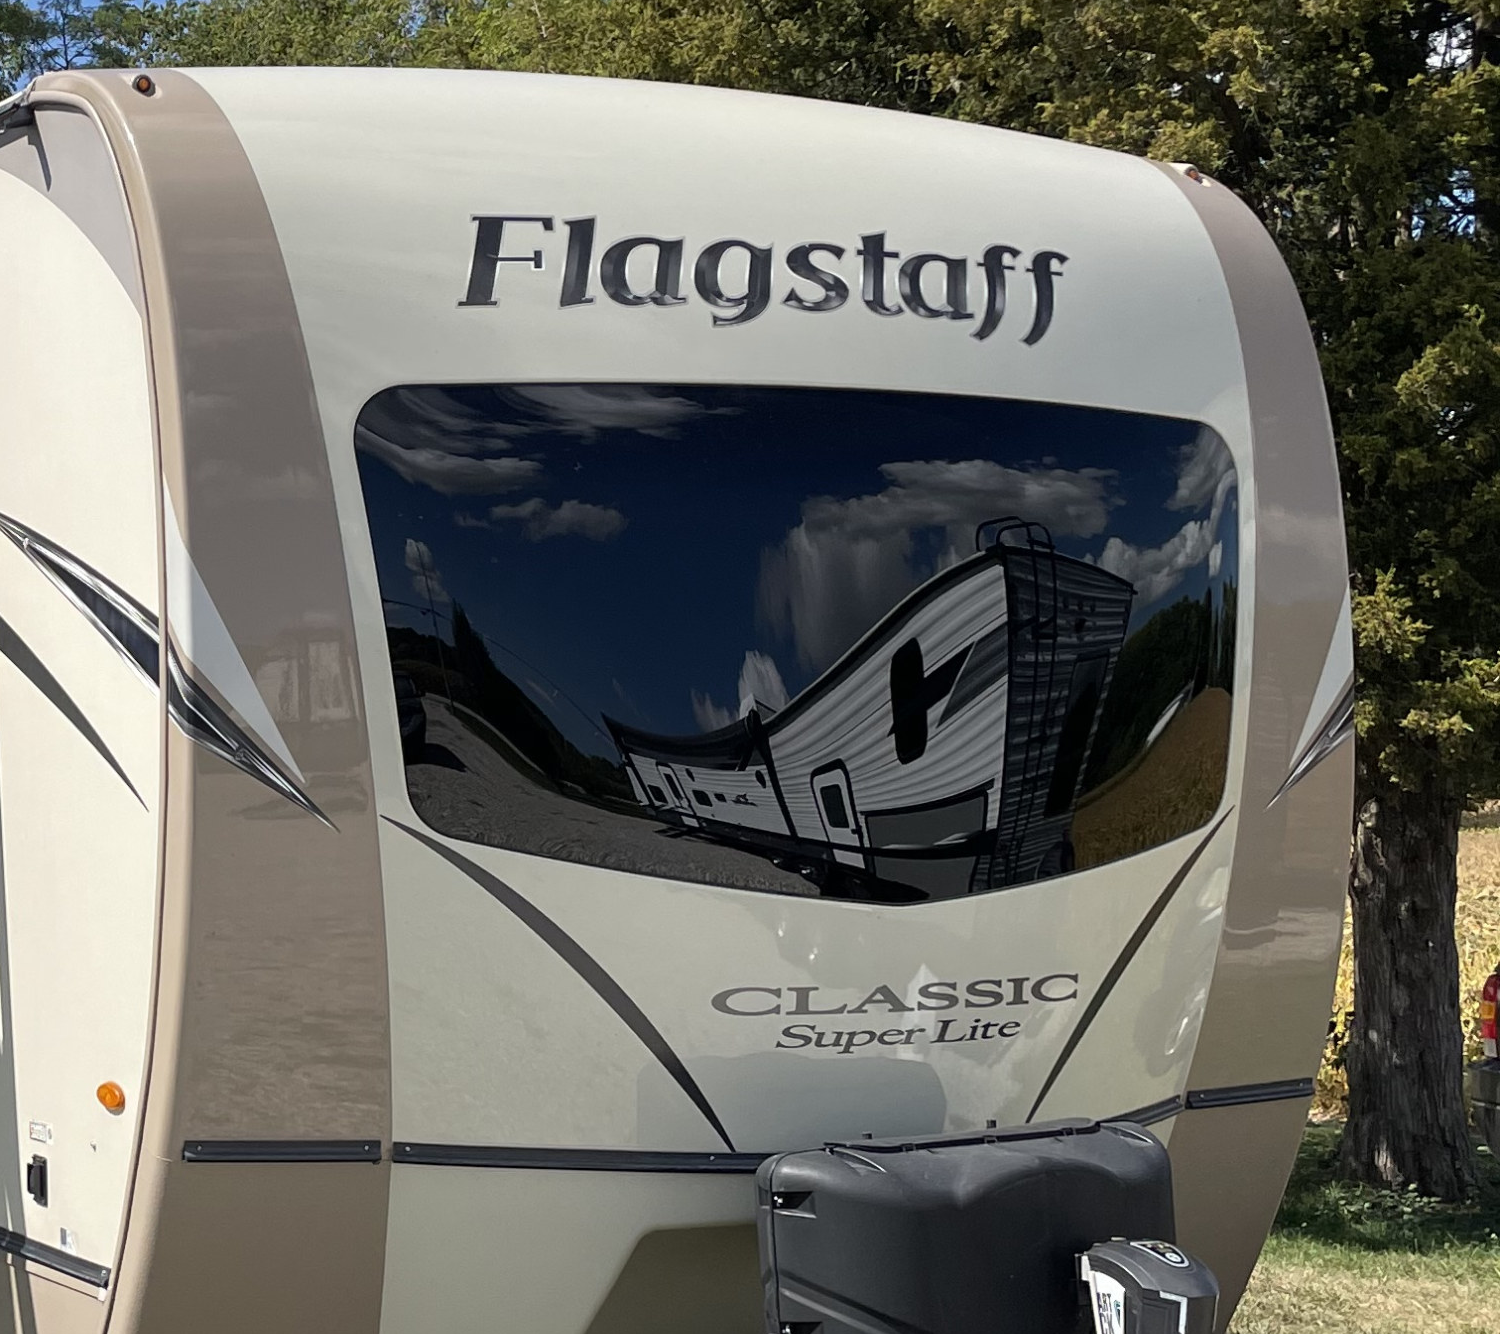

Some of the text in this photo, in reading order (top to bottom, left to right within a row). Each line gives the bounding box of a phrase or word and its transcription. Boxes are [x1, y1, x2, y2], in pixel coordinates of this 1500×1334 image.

[455, 213, 1071, 347] Flagstaff
[710, 973, 1079, 1017] CLASSIC
[774, 1017, 1021, 1055] Super Lite
